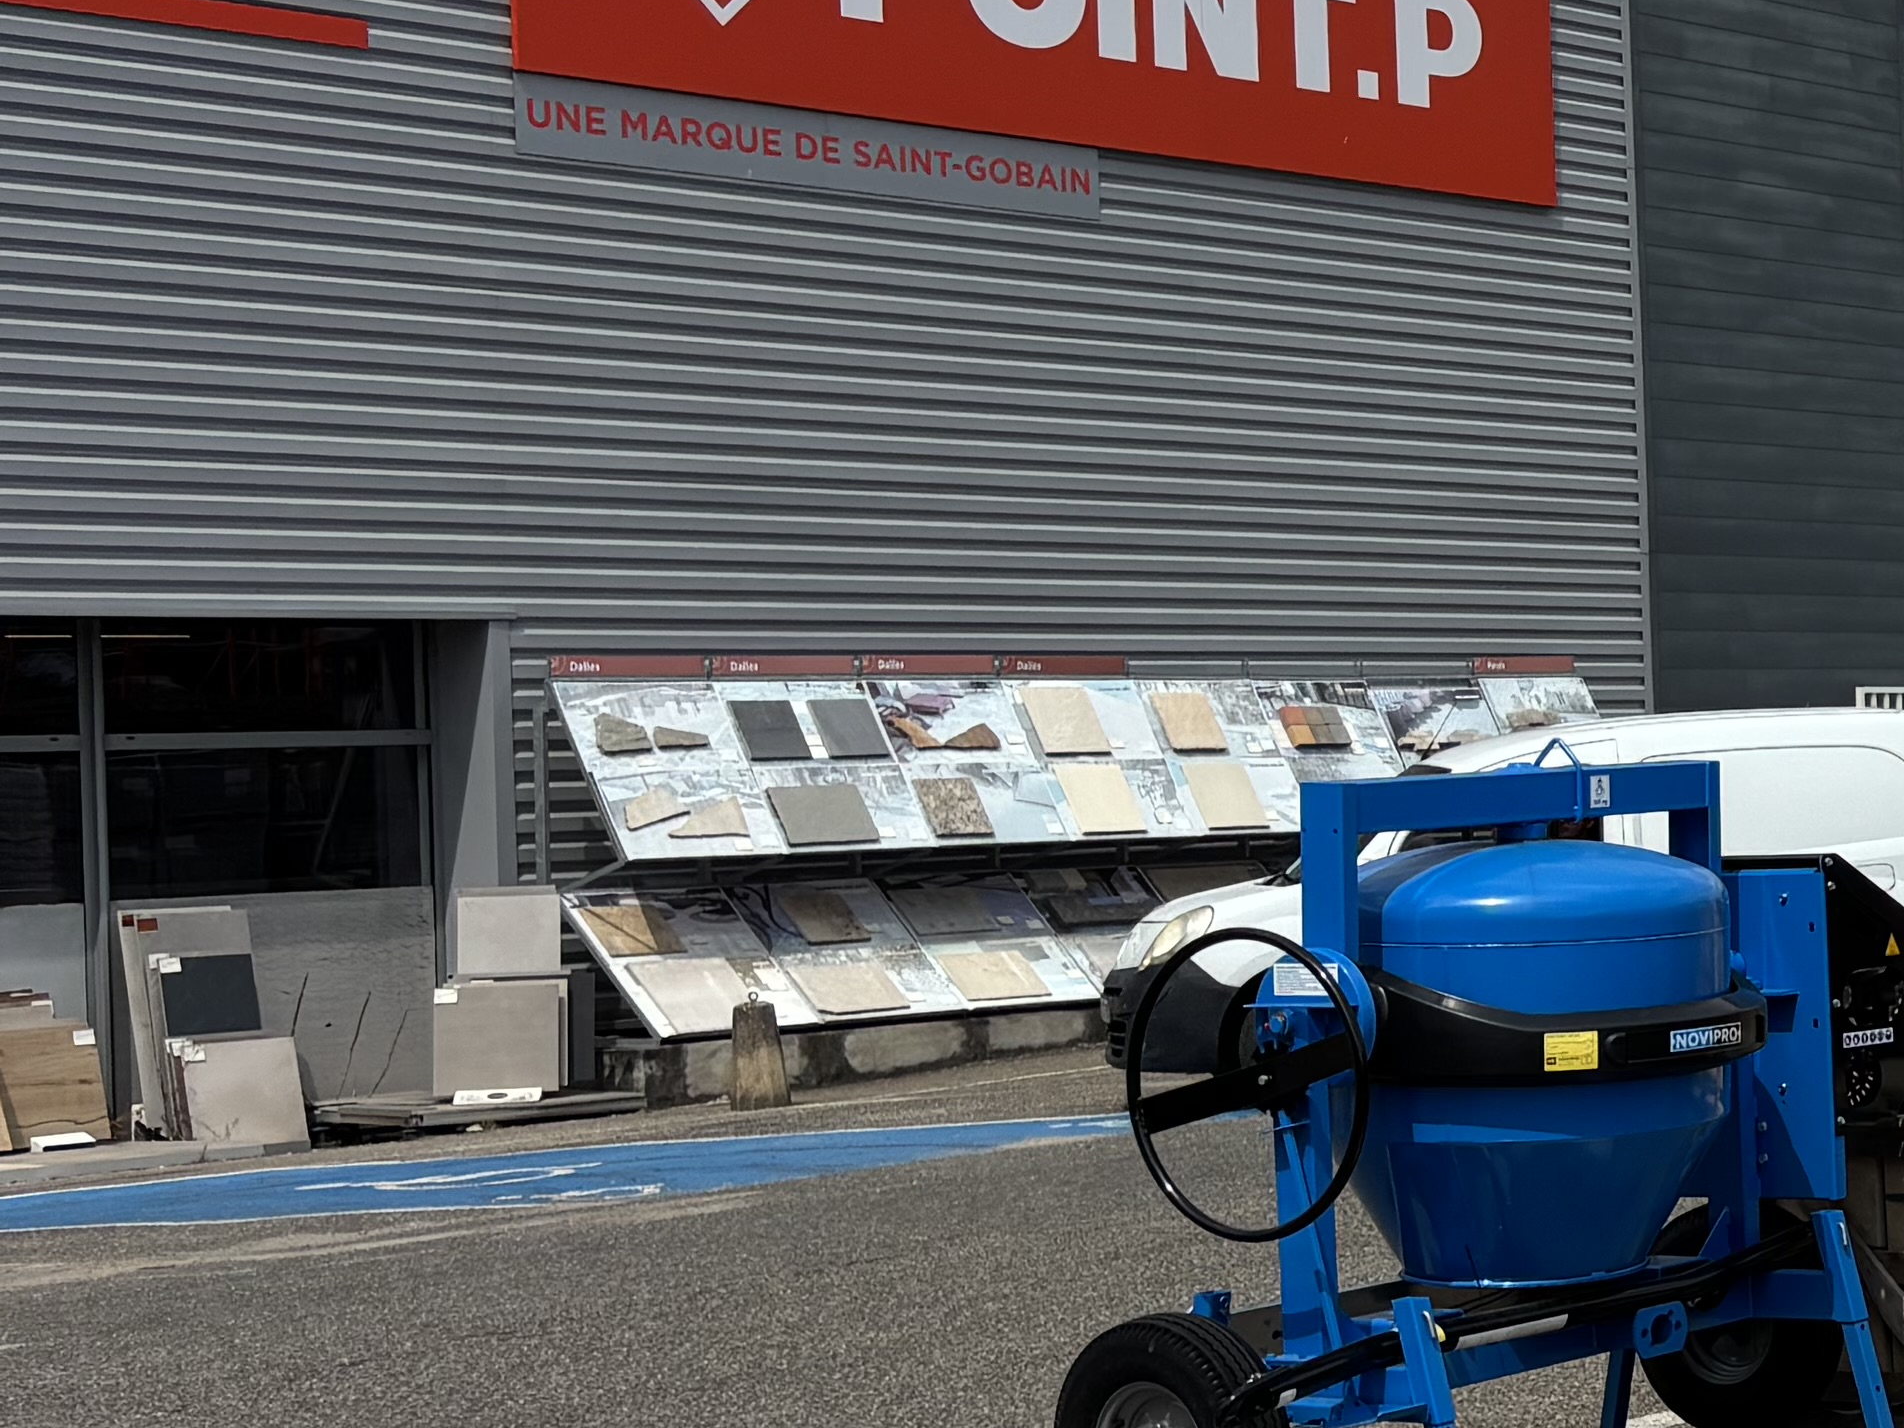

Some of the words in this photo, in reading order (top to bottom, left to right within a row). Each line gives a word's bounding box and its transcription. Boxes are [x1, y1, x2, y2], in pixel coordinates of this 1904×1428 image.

[525, 97, 606, 136] UNE
[620, 108, 782, 158] MARQUE
[795, 132, 841, 167] DE
[853, 139, 1091, 196] SAINT-GOBAIN
[1675, 1026, 1738, 1049] NOVIPRO
